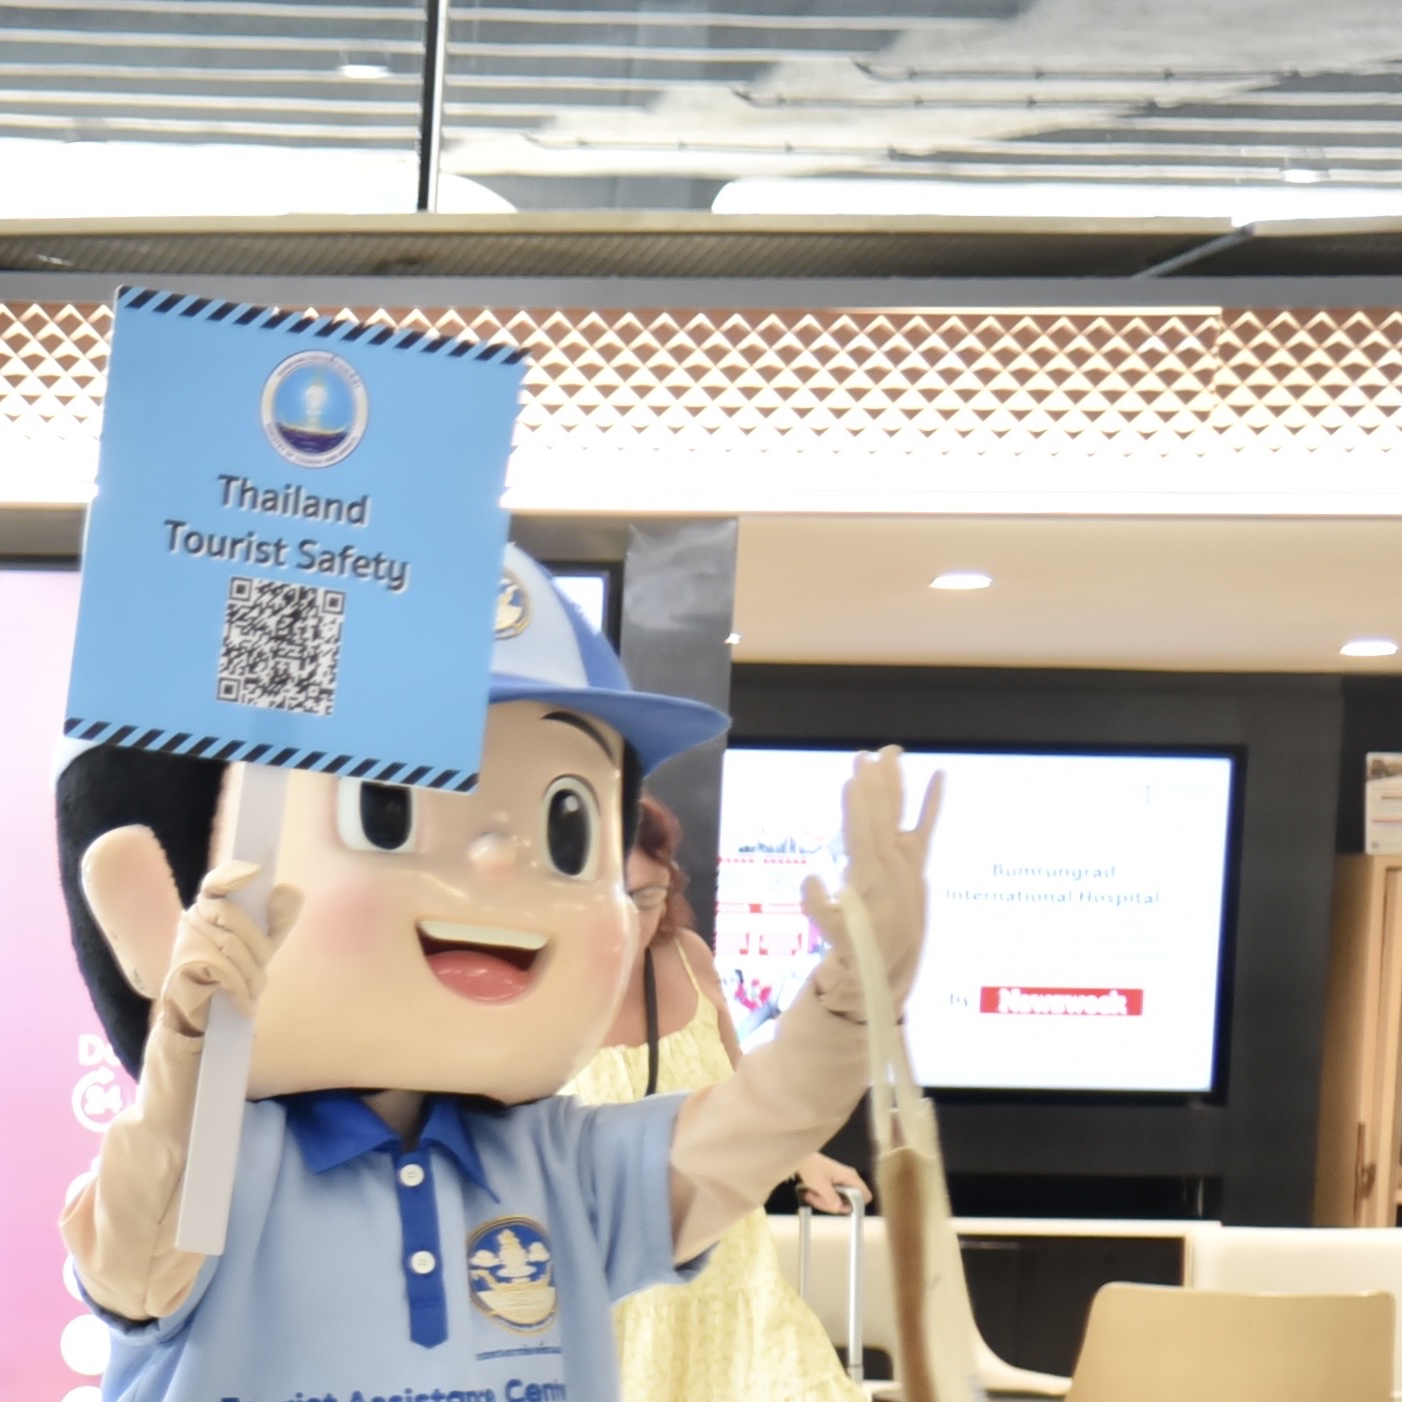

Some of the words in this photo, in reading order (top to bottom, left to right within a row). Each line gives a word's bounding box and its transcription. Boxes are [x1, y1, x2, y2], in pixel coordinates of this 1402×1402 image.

[218, 473, 370, 527] Thailand
[163, 518, 288, 568] Tourist
[296, 539, 410, 593] Safety
[993, 864, 1116, 882] Bumrungrad
[946, 888, 1072, 903] International
[1079, 890, 1160, 907] Hospital
[998, 987, 1128, 1016] Newsweek
